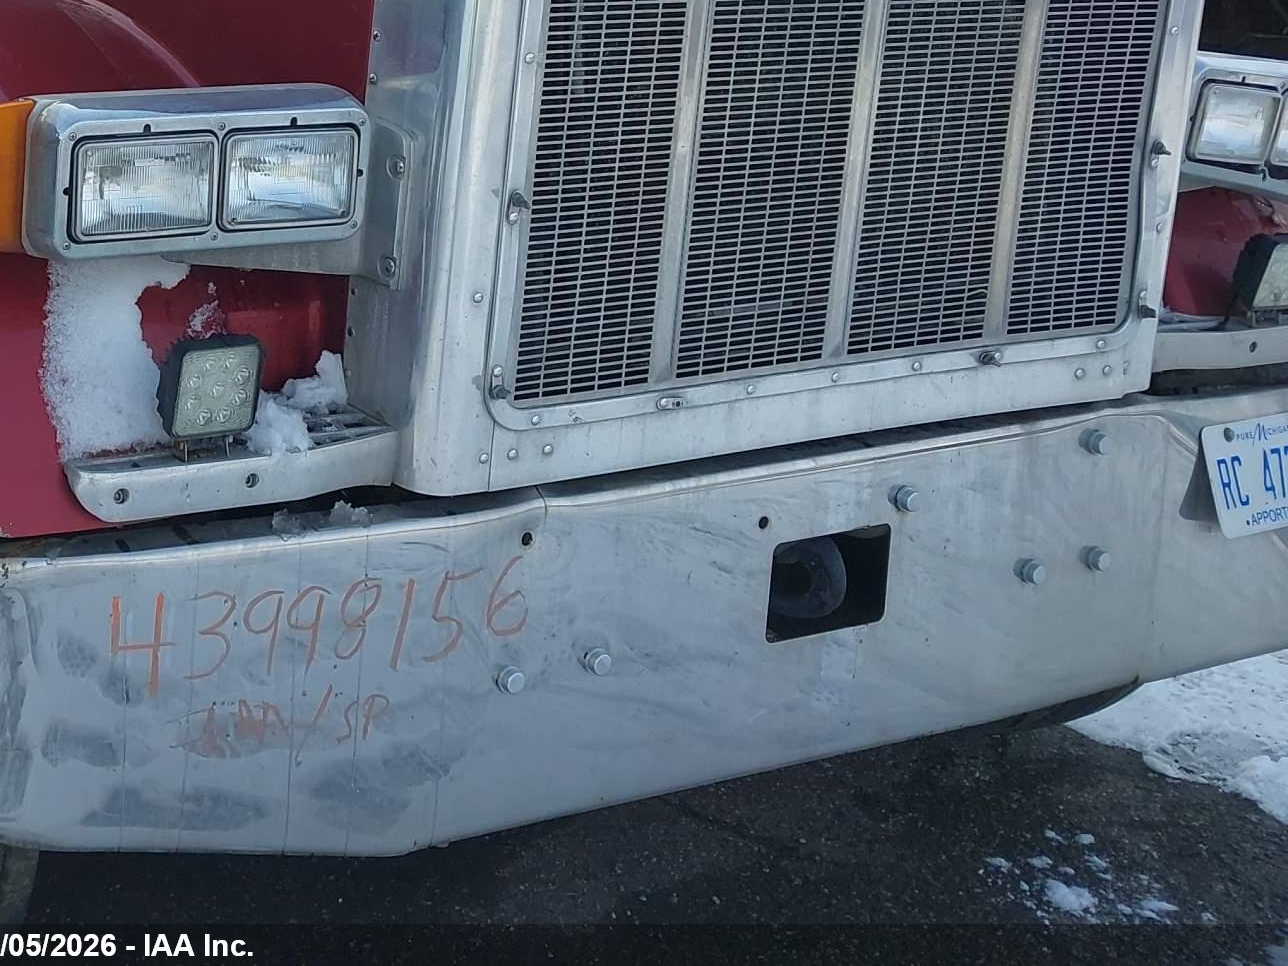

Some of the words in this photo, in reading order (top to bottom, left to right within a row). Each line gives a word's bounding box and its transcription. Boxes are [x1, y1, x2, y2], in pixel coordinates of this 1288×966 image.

[1216, 455, 1250, 510] RC
[1252, 506, 1288, 527] APPORT
[109, 555, 530, 697] 43998156
